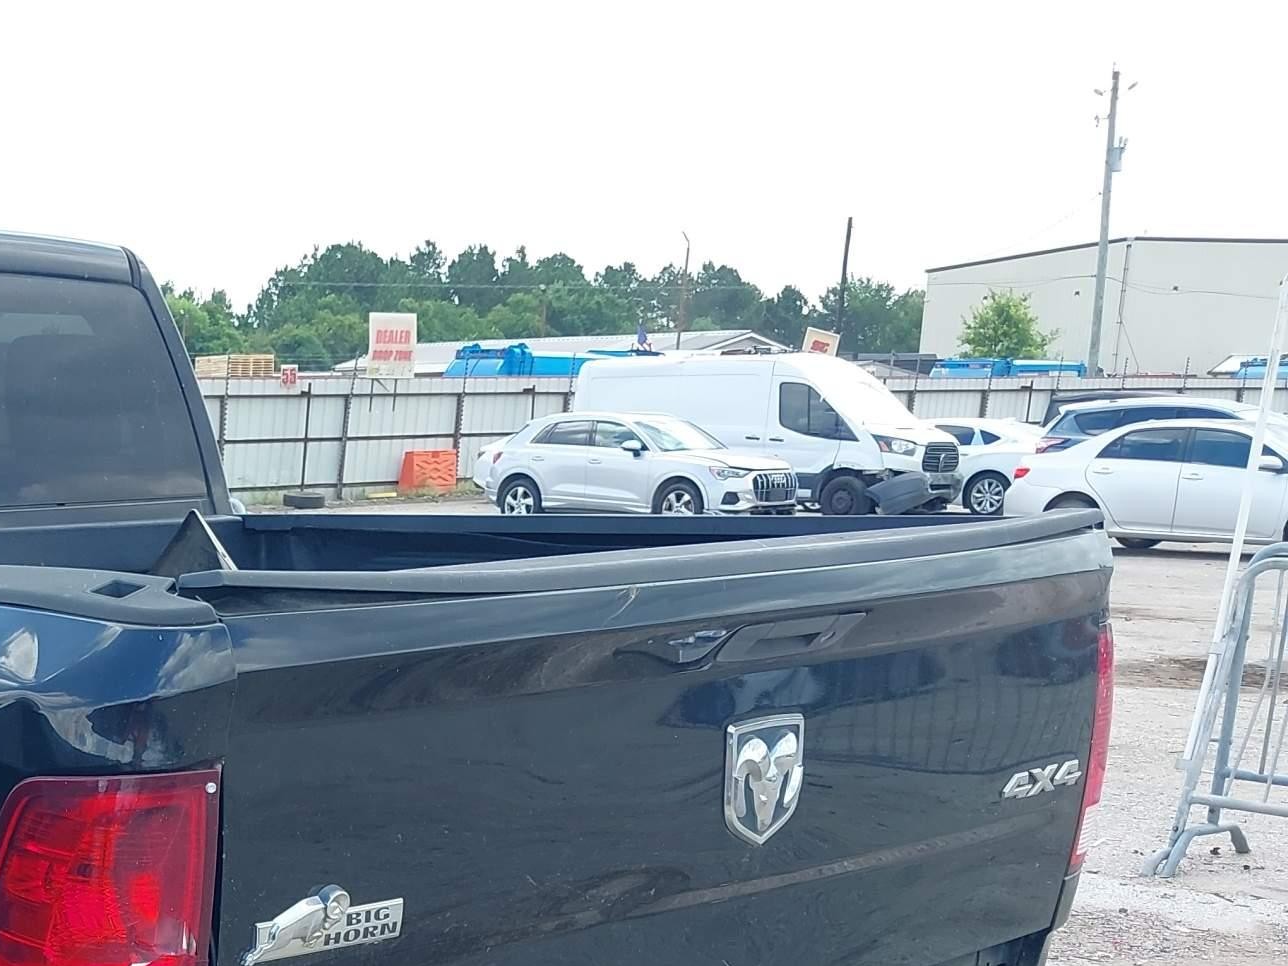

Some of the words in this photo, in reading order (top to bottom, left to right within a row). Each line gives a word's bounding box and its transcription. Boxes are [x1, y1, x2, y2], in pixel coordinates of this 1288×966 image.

[375, 329, 412, 345] DEALER
[345, 906, 390, 927] BIG
[323, 920, 398, 946] HORN
